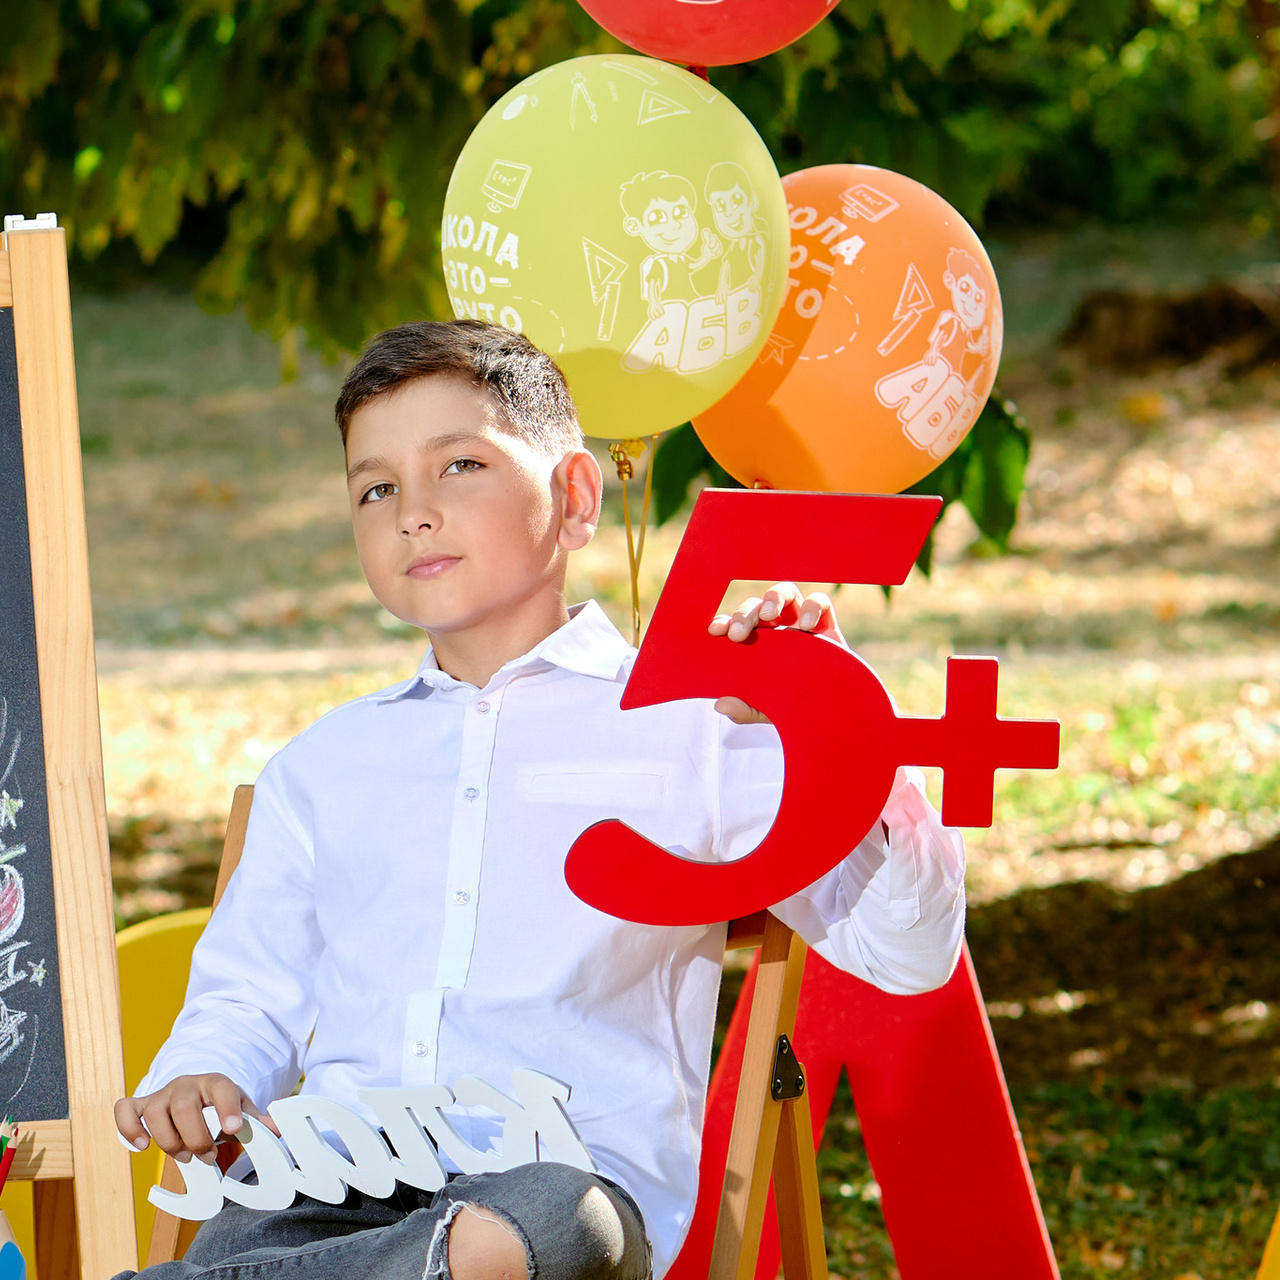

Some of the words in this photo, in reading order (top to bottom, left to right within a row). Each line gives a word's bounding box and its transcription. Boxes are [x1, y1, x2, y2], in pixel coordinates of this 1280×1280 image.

[787, 203, 866, 265] ОЛА
[452, 297, 523, 334] РУТО
[620, 283, 761, 375] АБВ
[874, 352, 980, 461] АБВ
[564, 487, 1061, 927] 5+
